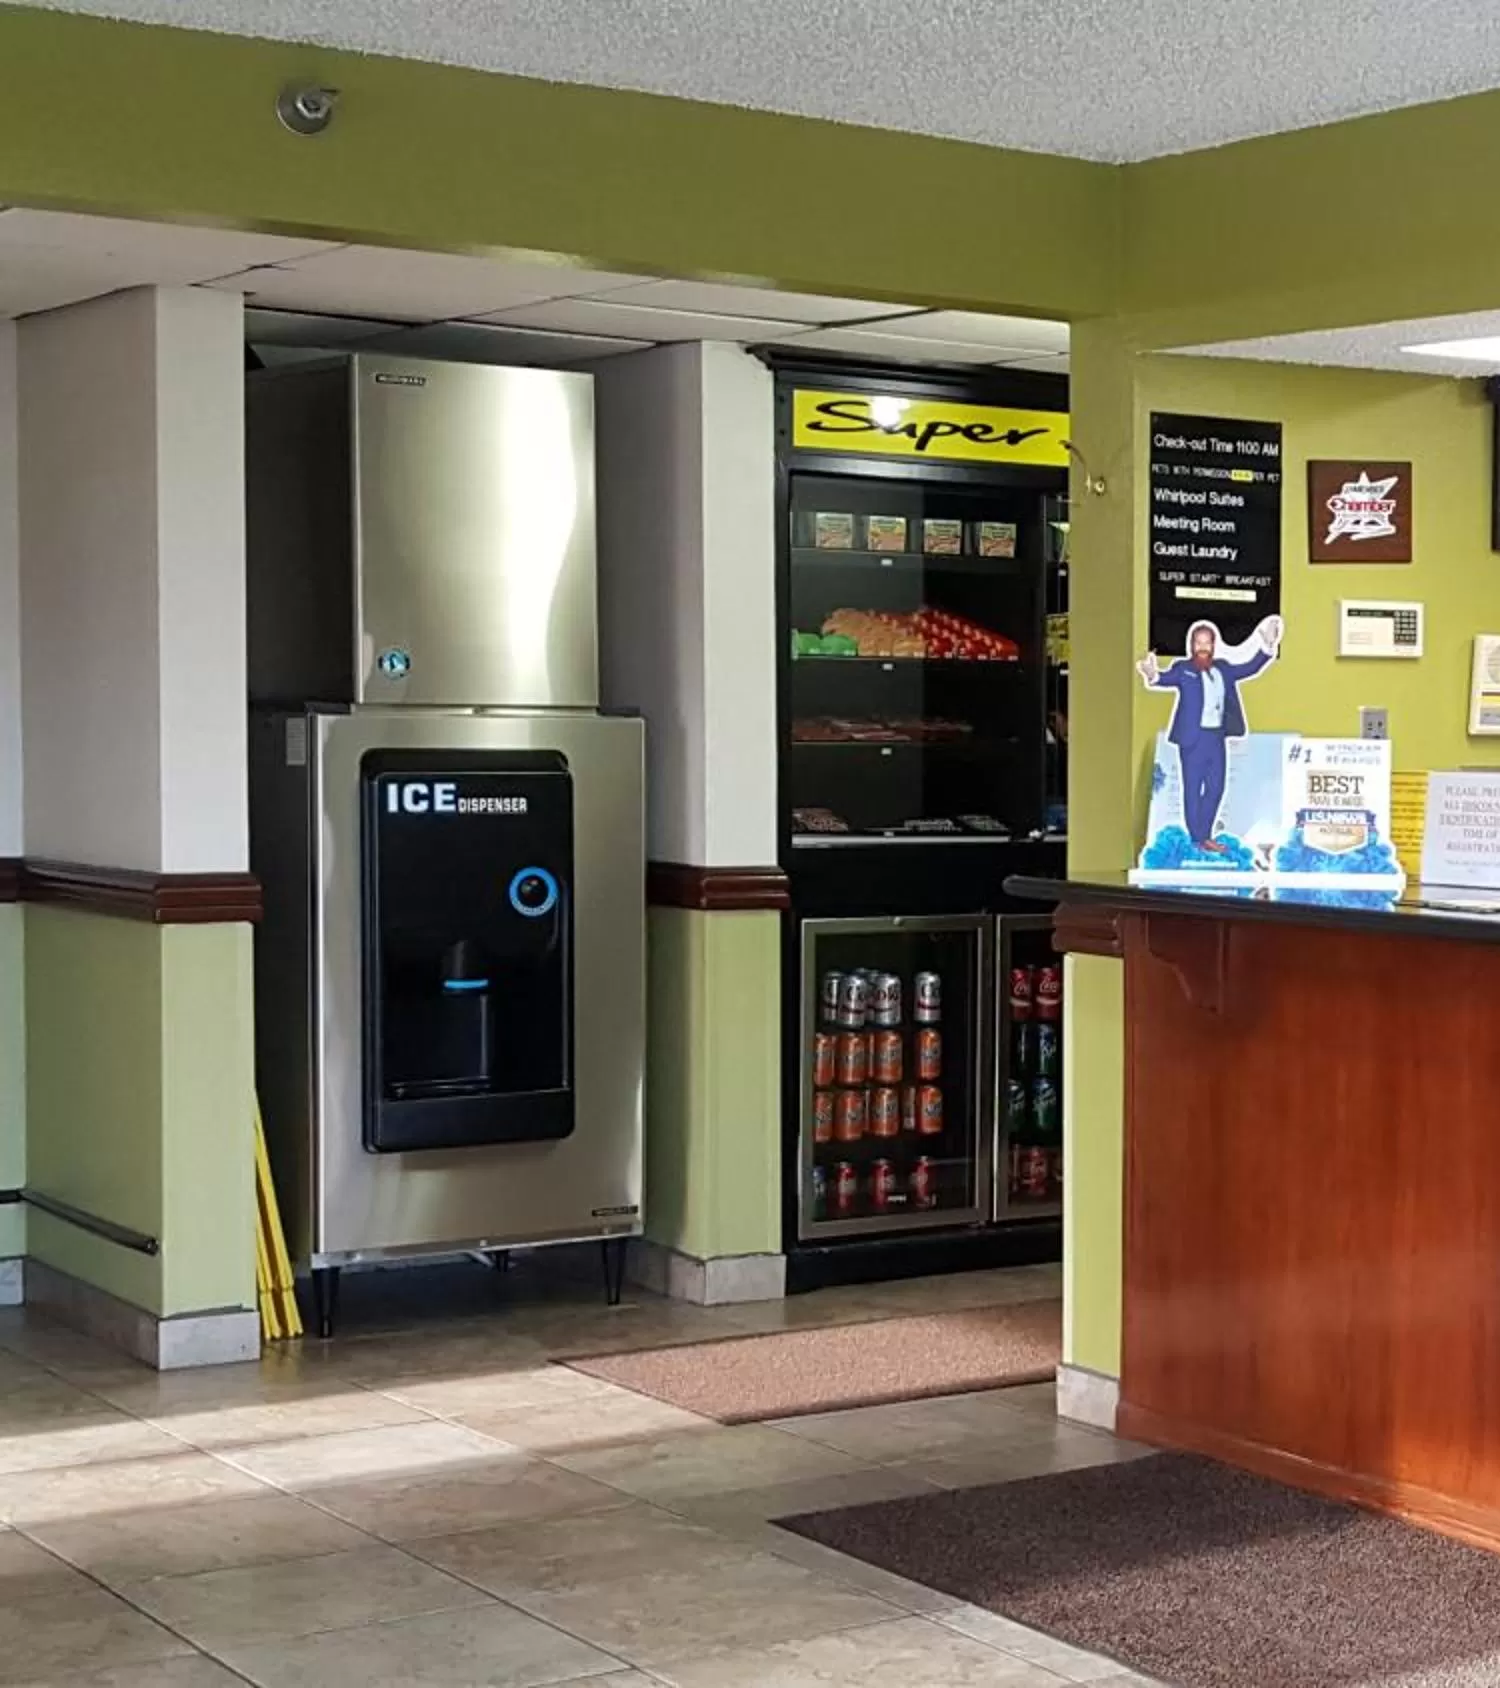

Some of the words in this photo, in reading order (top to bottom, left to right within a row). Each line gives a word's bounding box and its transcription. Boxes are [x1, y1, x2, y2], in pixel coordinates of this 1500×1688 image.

[806, 400, 1051, 451] Super
[1208, 437, 1234, 453] Time
[1261, 442, 1279, 457] AM
[1153, 487, 1207, 507] Whirlpool
[1209, 491, 1245, 507] Suites
[1153, 514, 1200, 534] Meeting
[1201, 517, 1237, 533] Room
[1153, 541, 1189, 557] Guest
[1191, 543, 1239, 562] Laundry
[1288, 743, 1313, 763] #1
[1309, 774, 1365, 795] BEST
[387, 783, 457, 813] ICE
[458, 797, 527, 814] DISPENSER
